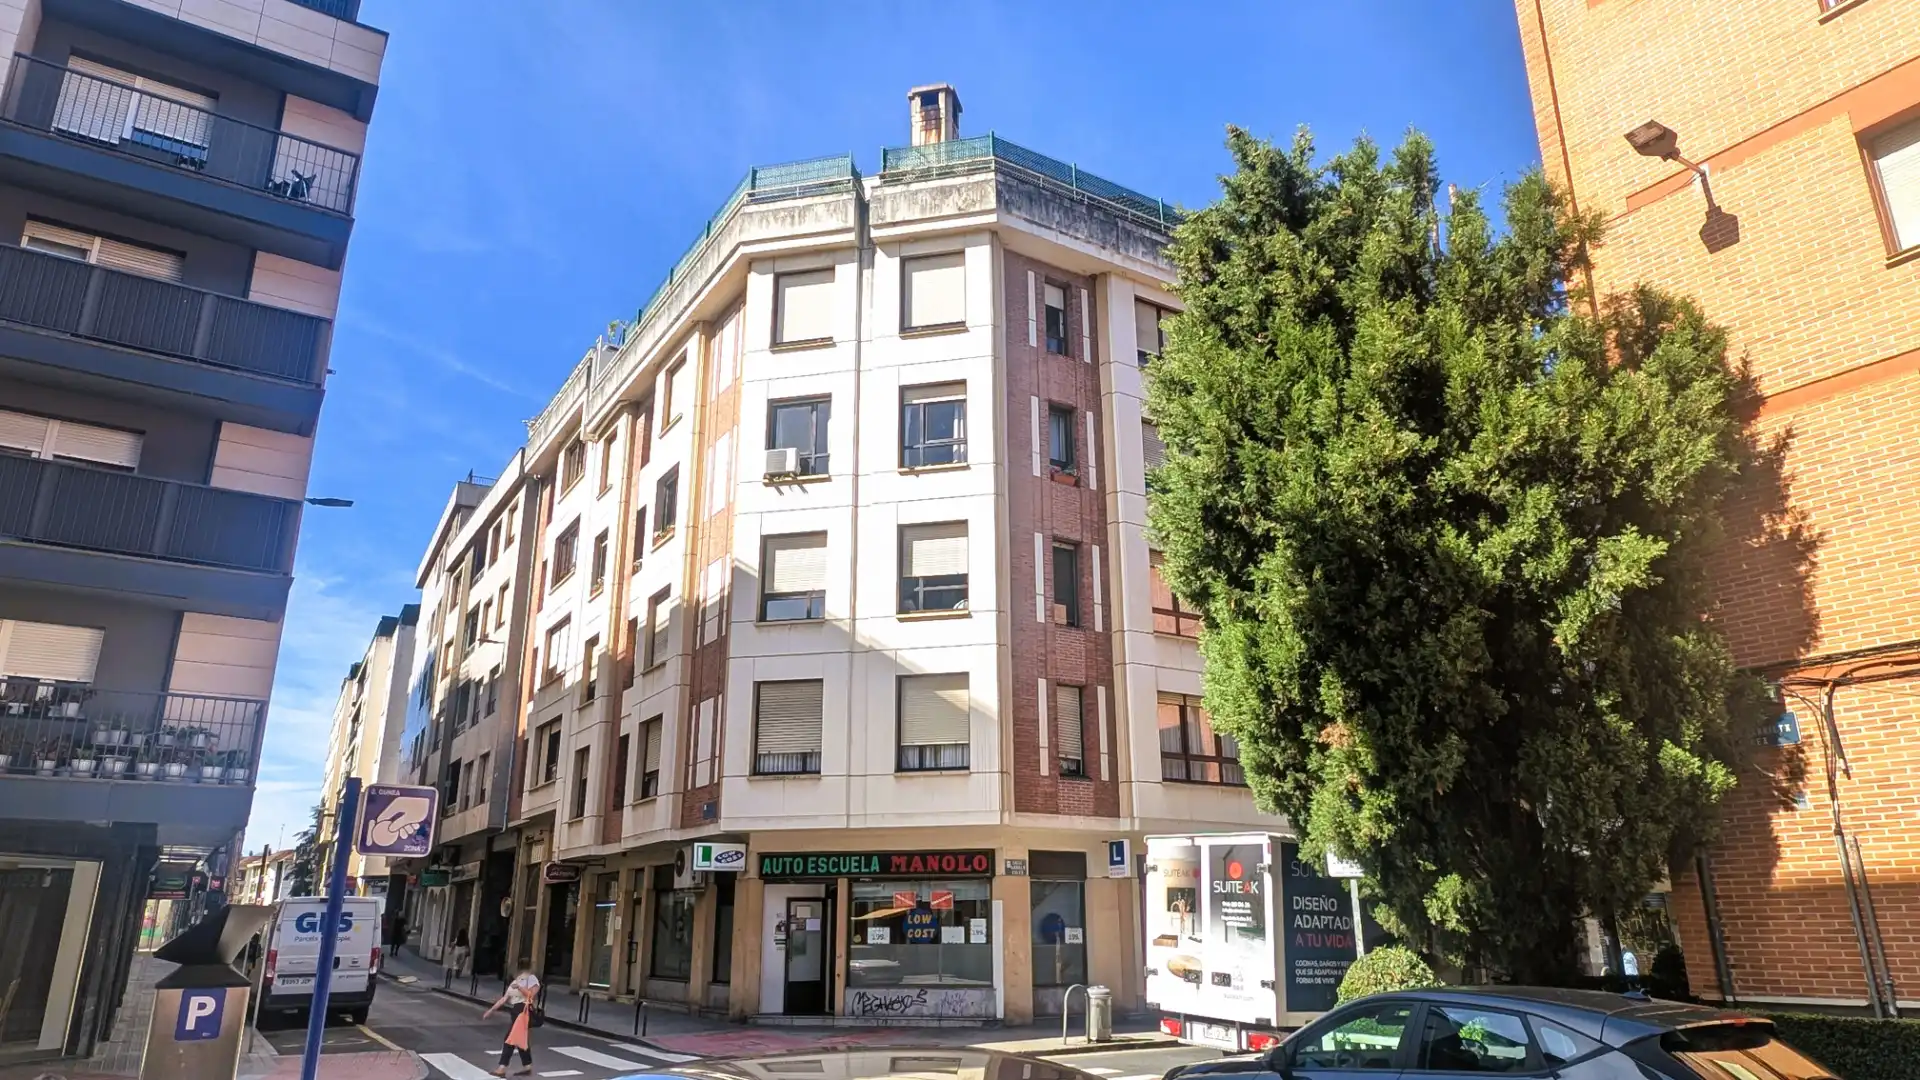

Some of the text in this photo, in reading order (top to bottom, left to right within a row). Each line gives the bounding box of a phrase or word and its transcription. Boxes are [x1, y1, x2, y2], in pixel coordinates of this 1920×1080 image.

[1113, 844, 1121, 861] L
[762, 856, 803, 875] AUTO
[807, 855, 880, 874] ESCUELA
[890, 854, 988, 872] MANOLO
[1213, 880, 1259, 894] SUITEAK
[1292, 894, 1338, 912] DISEÑO
[907, 913, 932, 925] LOW
[1293, 915, 1354, 930] ADAPTAD
[907, 928, 935, 938] COST
[1295, 934, 1355, 948] A TU VIDA
[185, 996, 216, 1031] P
